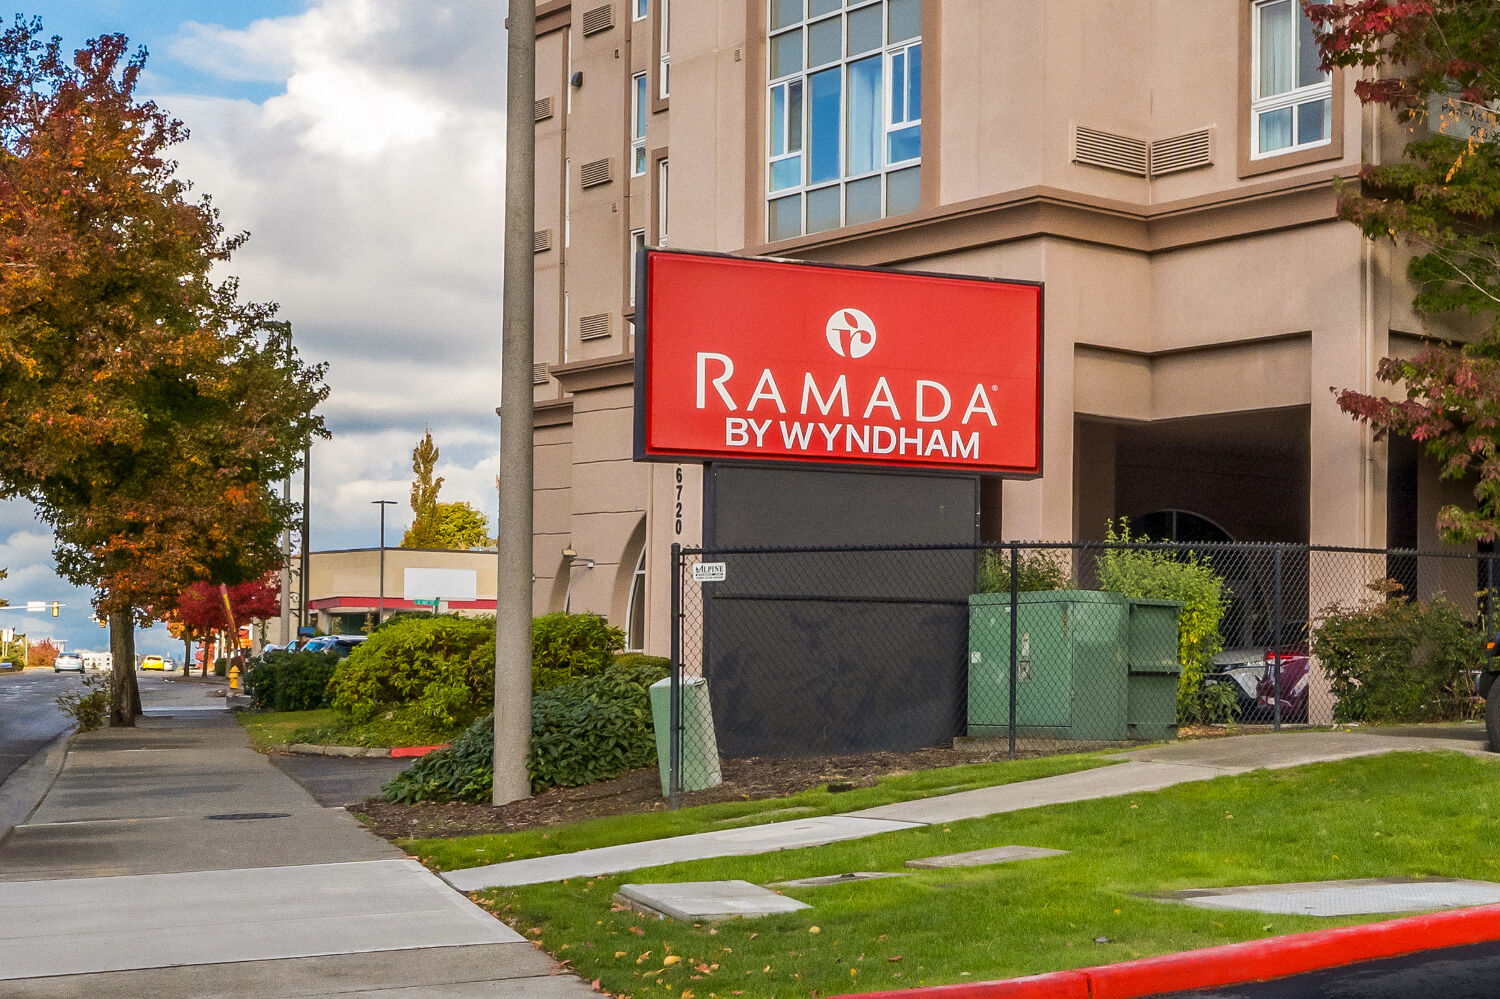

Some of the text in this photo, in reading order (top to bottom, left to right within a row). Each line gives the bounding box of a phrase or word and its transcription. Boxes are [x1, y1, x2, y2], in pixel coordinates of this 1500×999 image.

[696, 352, 998, 427] RAMADA
[725, 417, 980, 460] BY WYNDHAM
[675, 463, 683, 535] 6720
[698, 564, 724, 574] ALPINE
